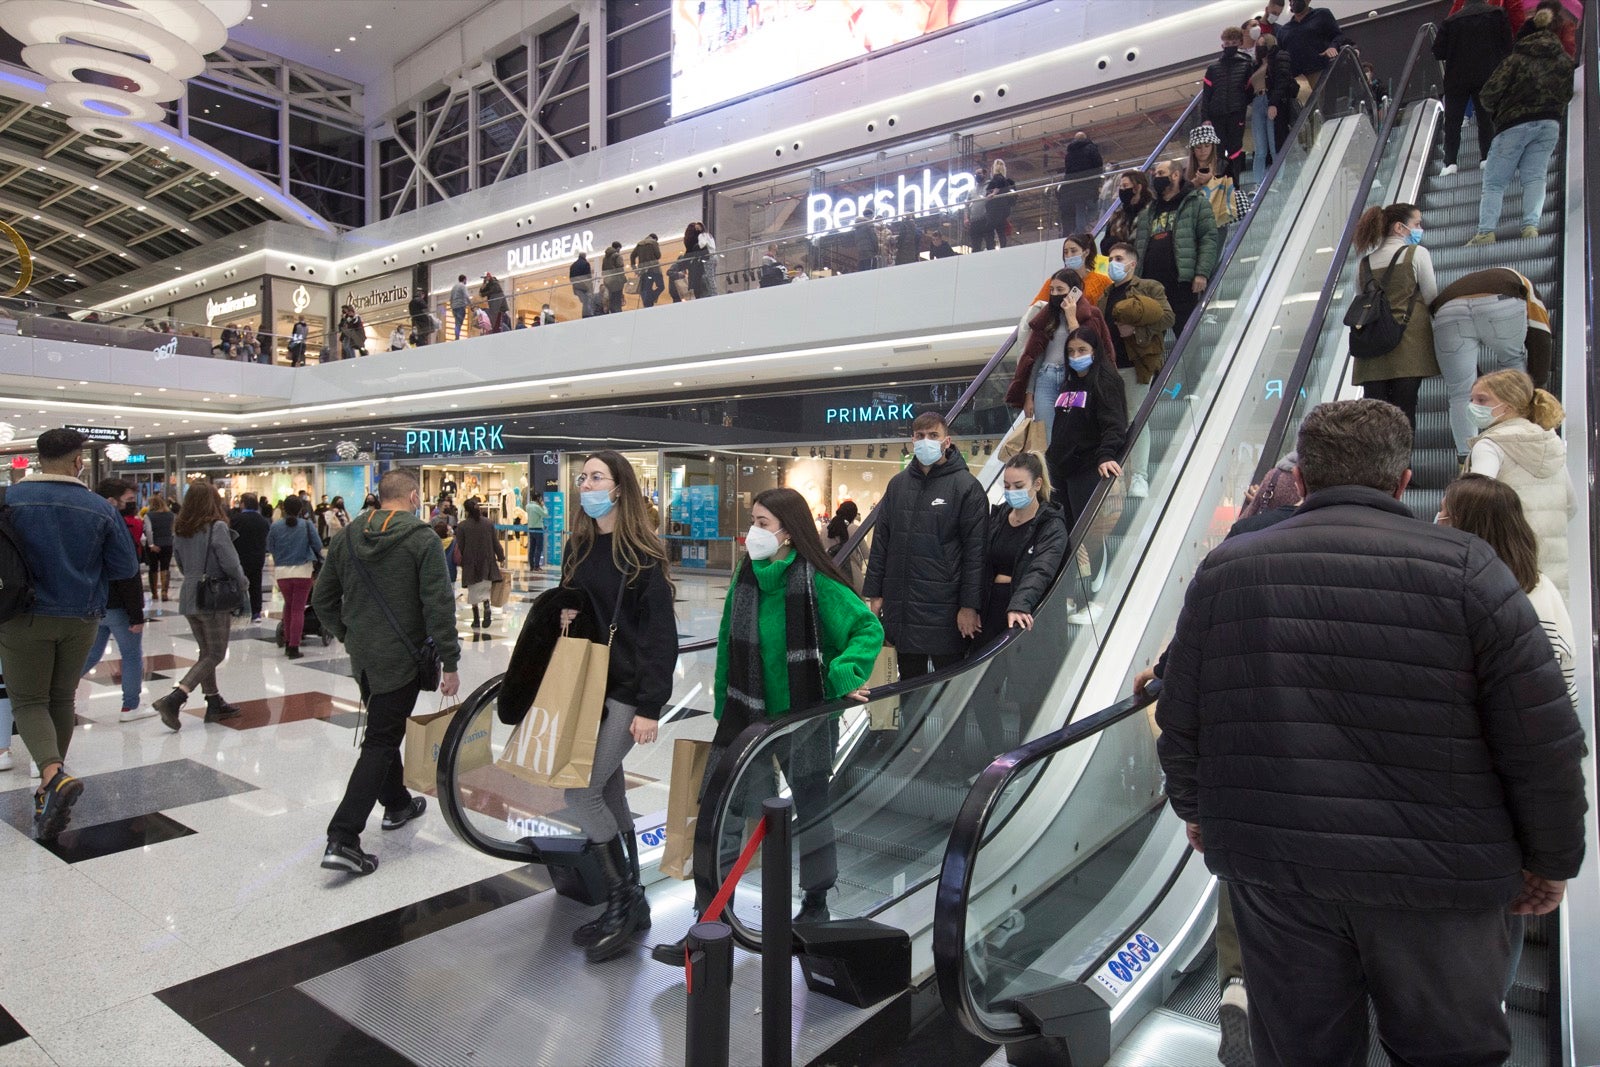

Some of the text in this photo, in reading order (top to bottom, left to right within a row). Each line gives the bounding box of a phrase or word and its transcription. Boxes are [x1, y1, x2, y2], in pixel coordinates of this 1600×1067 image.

[806, 168, 976, 238] Bershka
[507, 230, 594, 271] PULL&BEAR
[826, 403, 914, 424] PRIMARK
[406, 424, 504, 454] PRIMARK
[1097, 975, 1118, 994] OTIS
